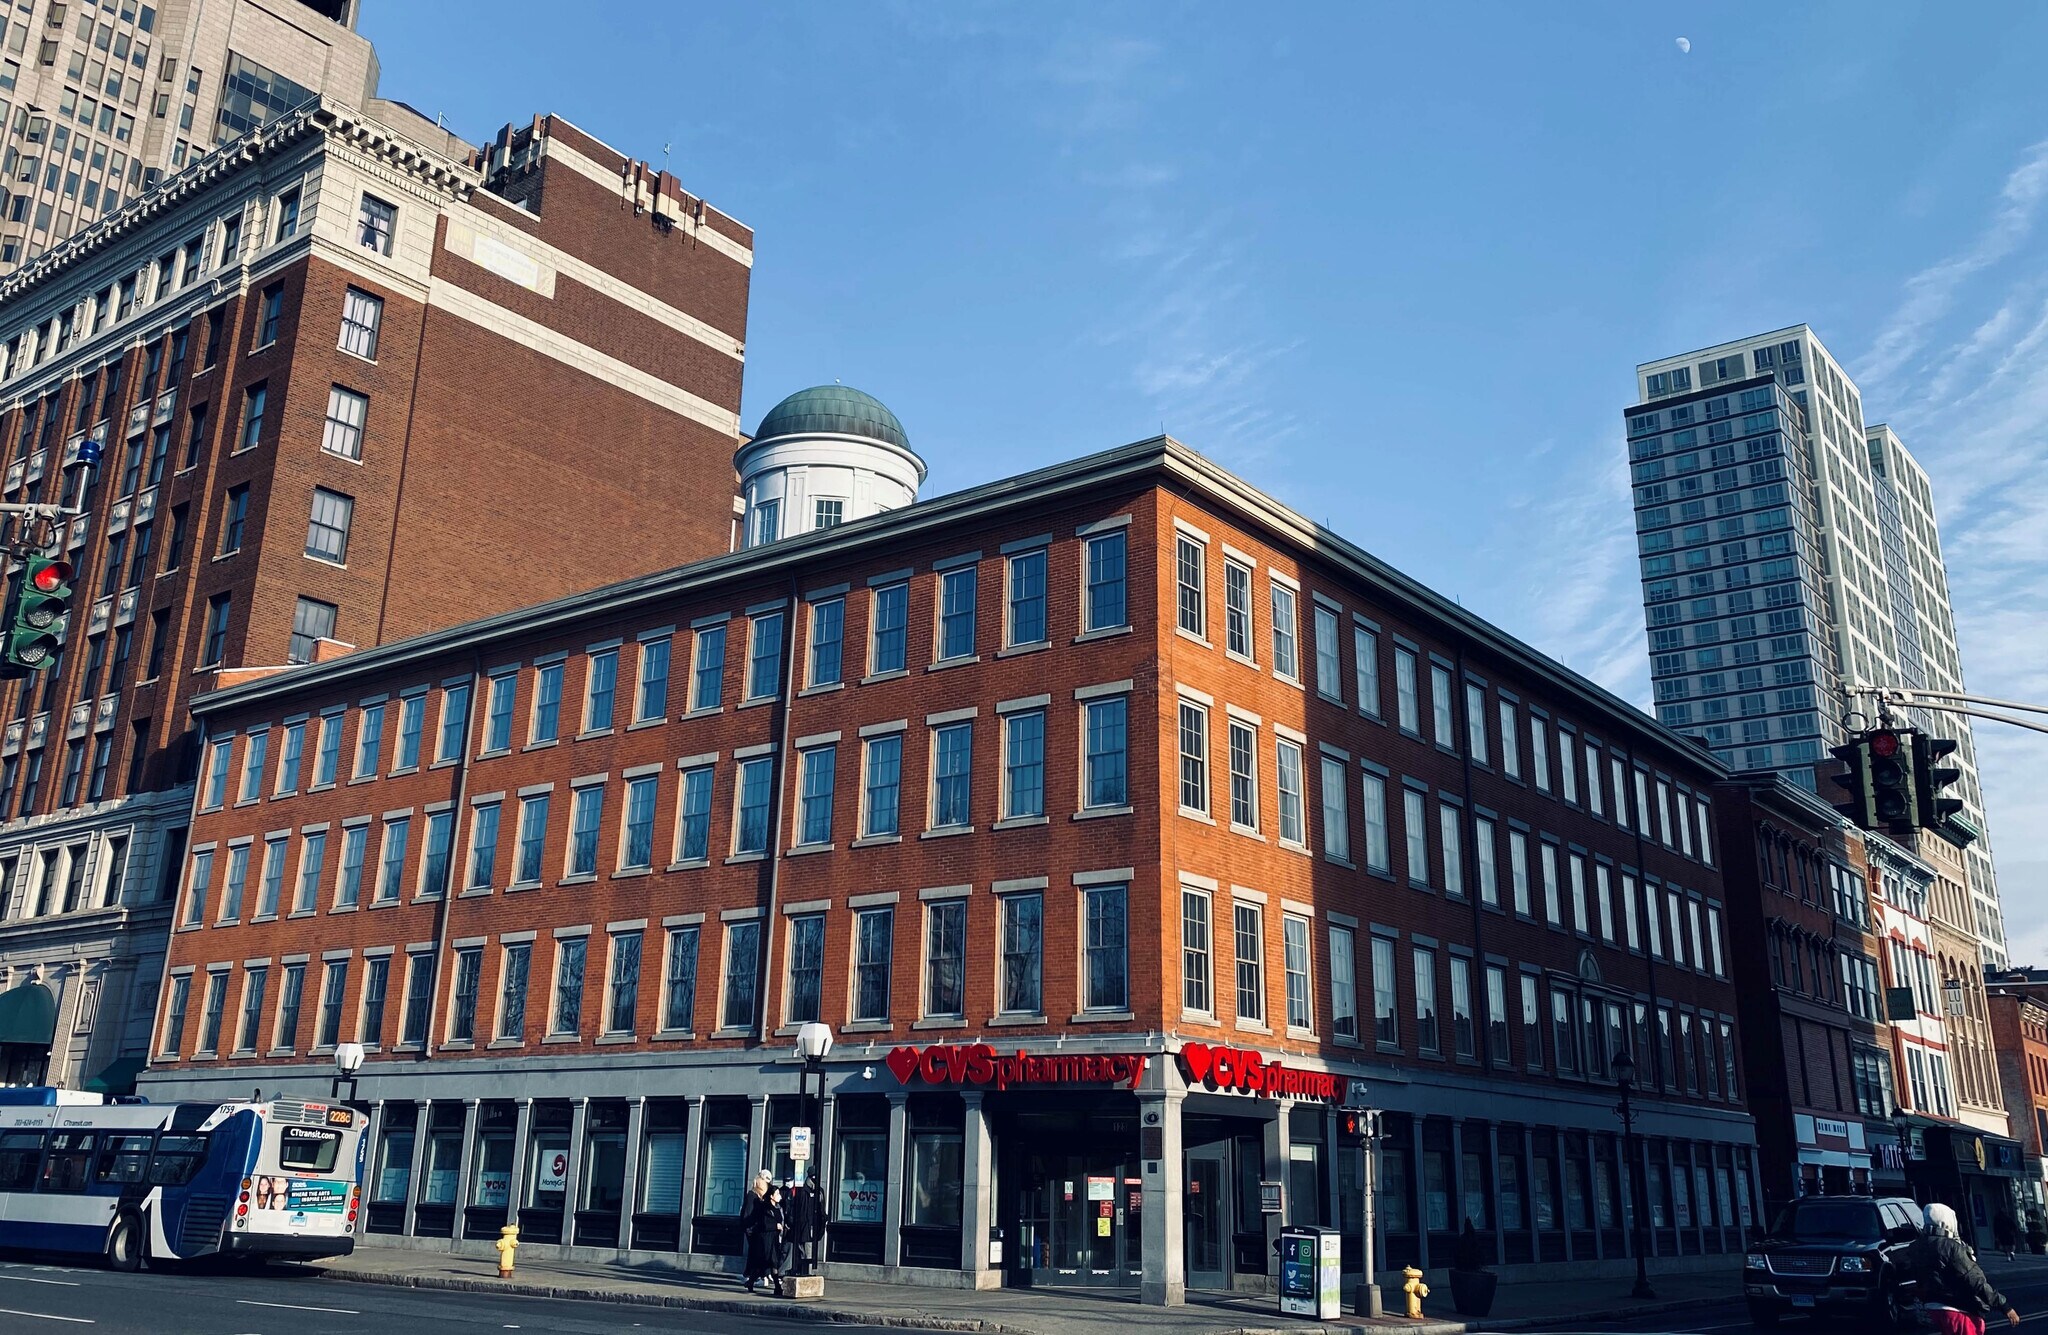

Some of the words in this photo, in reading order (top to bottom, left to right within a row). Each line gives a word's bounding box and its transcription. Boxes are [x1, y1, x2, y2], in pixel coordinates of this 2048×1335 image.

[1948, 989, 1961, 1003] LU
[1950, 1003, 1963, 1016] LU
[920, 1044, 996, 1084] CVS
[997, 1050, 1147, 1091] pharmacy
[1210, 1046, 1263, 1090] CVS
[1263, 1061, 1348, 1105] pharmacy
[220, 1105, 236, 1114] 1759
[290, 1128, 336, 1140] CTtransit.com
[492, 1180, 507, 1190] CVS
[858, 1190, 878, 1202] CVS
